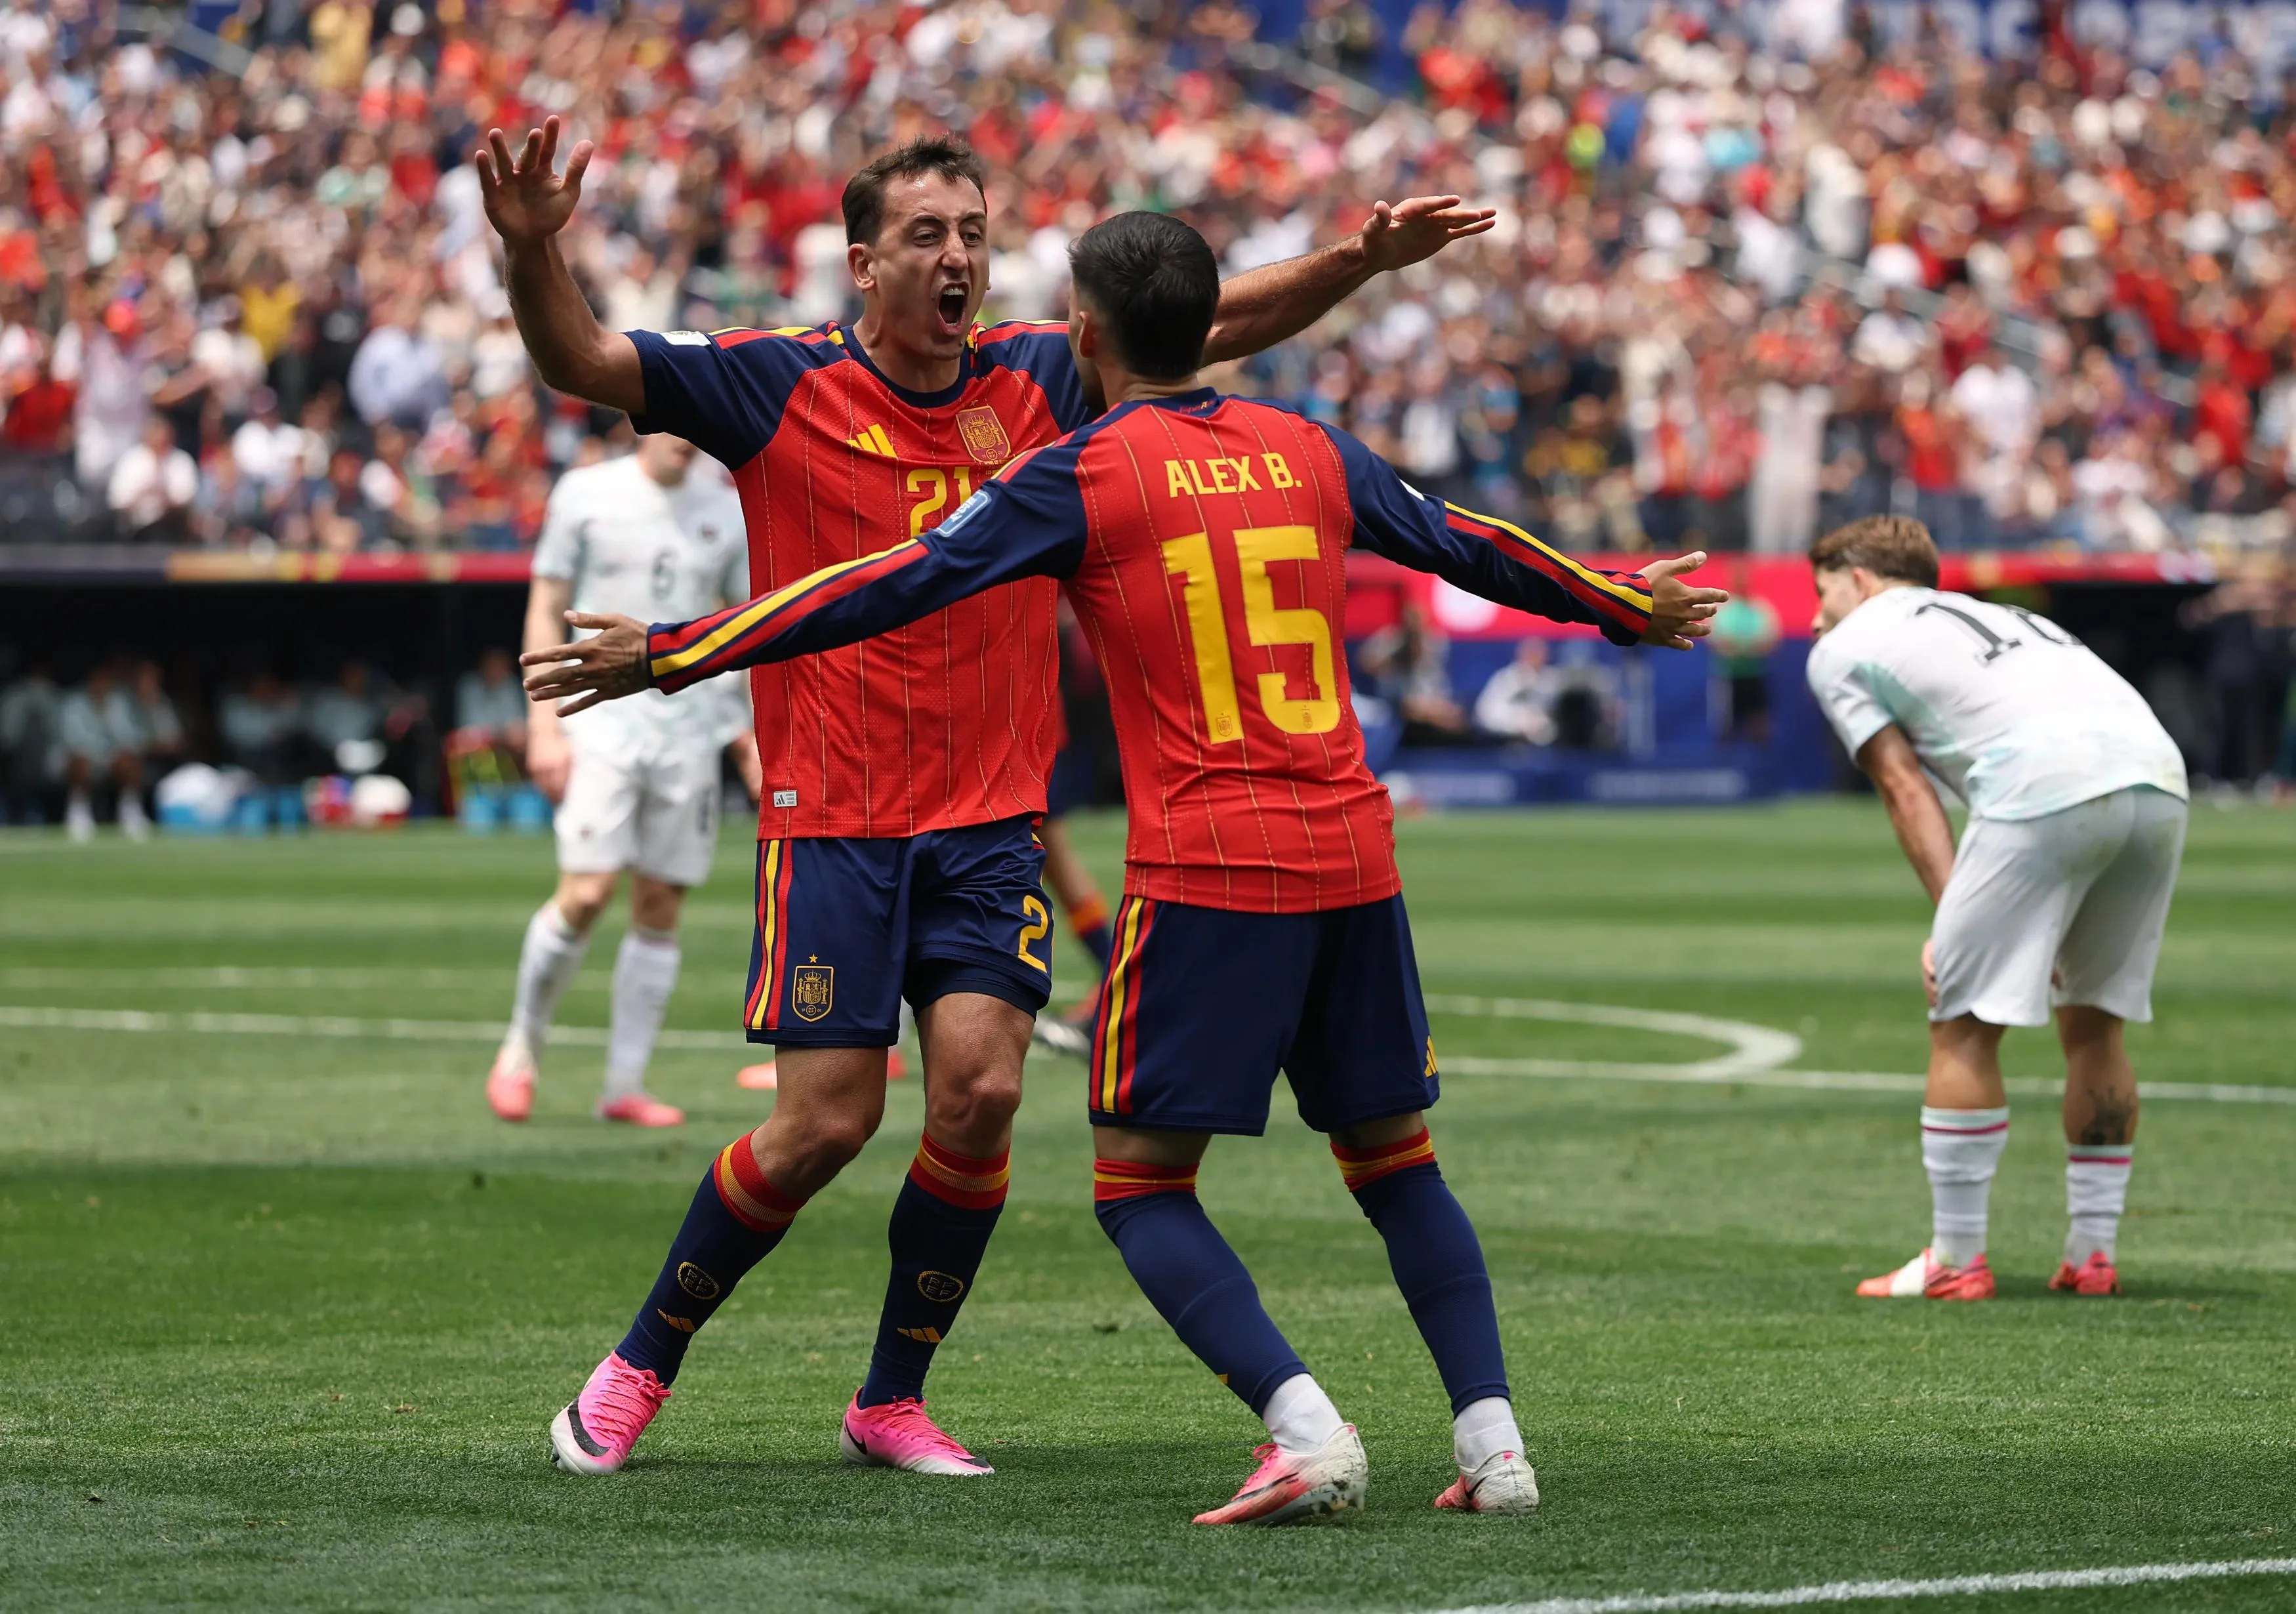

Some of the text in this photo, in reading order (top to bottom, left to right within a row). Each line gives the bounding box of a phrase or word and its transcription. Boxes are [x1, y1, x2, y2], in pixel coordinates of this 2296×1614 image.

[907, 466, 972, 538] 21
[1164, 453, 1303, 498] ALEX B.
[650, 546, 680, 602] 6
[1162, 526, 1341, 745] 15
[1018, 894, 1054, 974] 2
